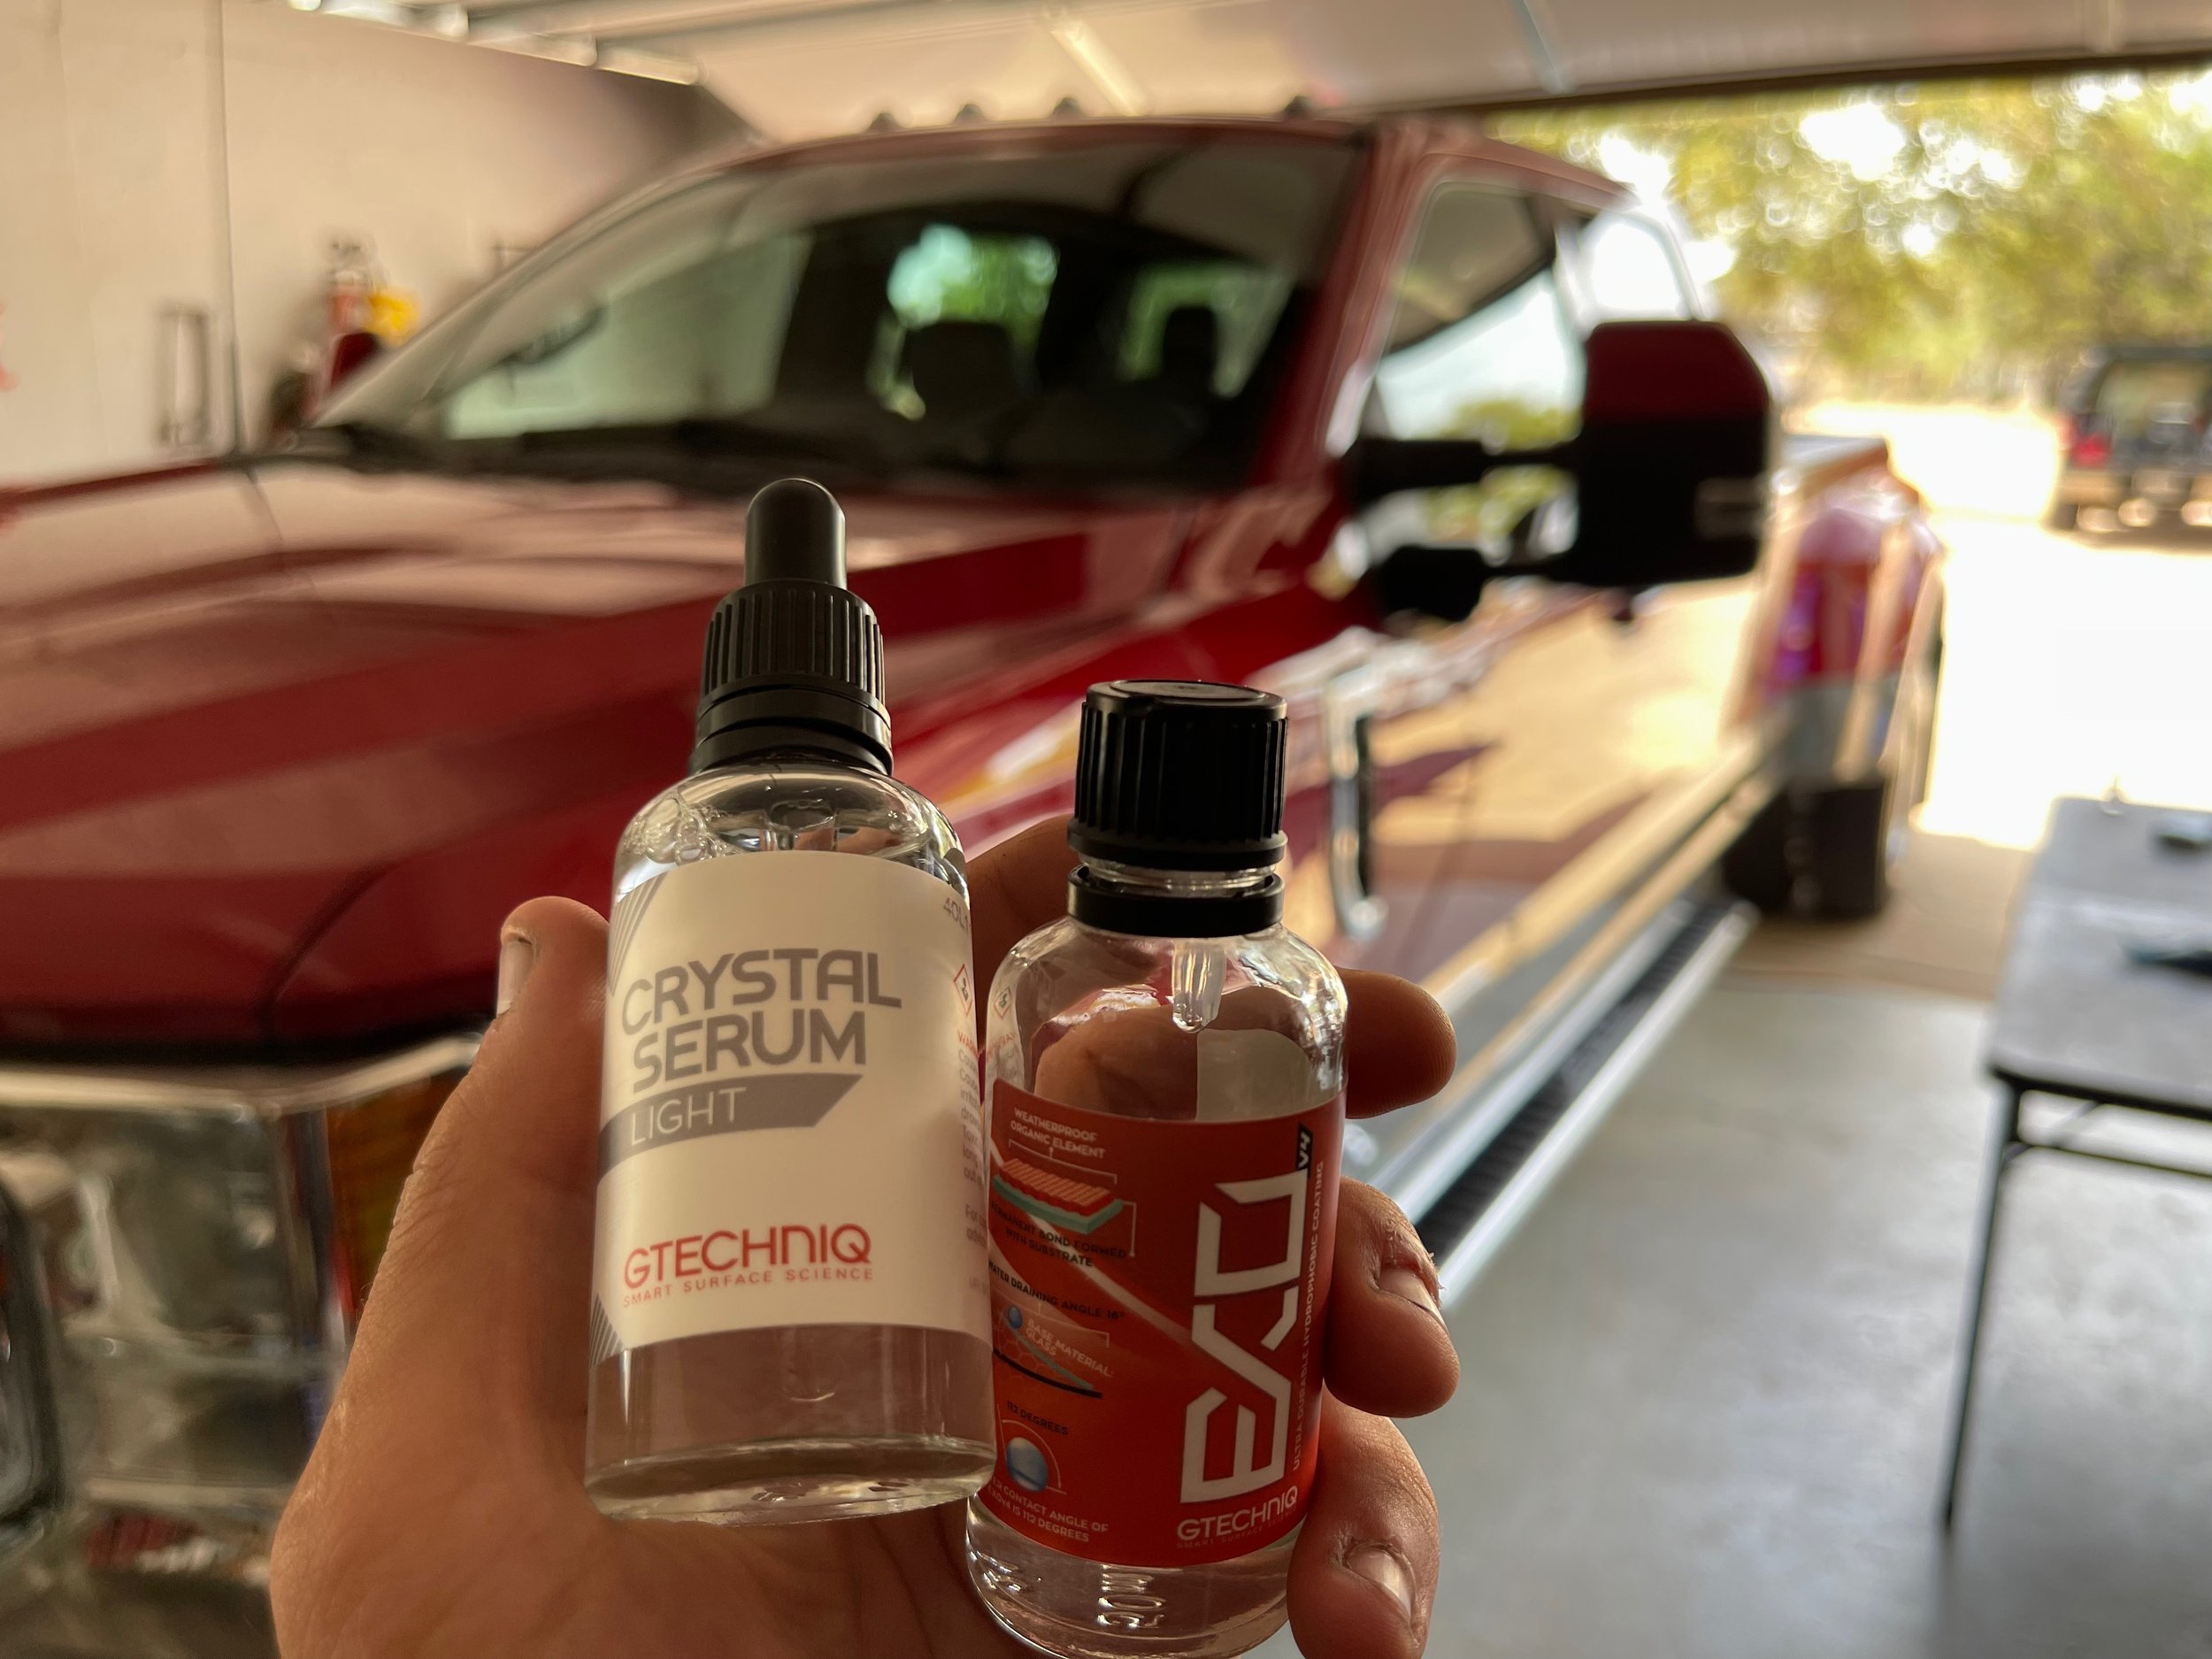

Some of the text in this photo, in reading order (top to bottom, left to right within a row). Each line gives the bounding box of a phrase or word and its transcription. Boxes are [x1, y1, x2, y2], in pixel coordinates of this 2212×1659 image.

[622, 947, 902, 1036] CRYSTAL
[634, 1009, 866, 1094] SERUM
[630, 1087, 747, 1145] LIGHT
[1014, 1107, 1098, 1142] WEATHERPROOF
[1010, 1120, 1051, 1146] ORGANIC
[1052, 1137, 1106, 1159] ELEMENT
[625, 1223, 872, 1289] GTECHNIQ
[1005, 1228, 1027, 1244] WITH
[1029, 1239, 1094, 1267] SUBSTRATE
[1039, 1228, 1070, 1247] BOND
[1074, 1239, 1127, 1259] FORMED
[623, 1267, 873, 1308] SMART SURFACE SCIENCE
[1010, 1278, 1058, 1305] DRAINING
[1062, 1301, 1102, 1317] ANGLE
[1028, 1318, 1054, 1343] BASE
[1179, 1169, 1309, 1503] EXO
[1293, 1161, 1325, 1471] ULTRA DURABLE HYDROPHOBIC COATING
[1025, 1327, 1057, 1356] GLASS
[1020, 1409, 1069, 1435] DEGREES
[1003, 1486, 1048, 1516] CONTACT
[1049, 1510, 1088, 1529] ANGLE
[1092, 1522, 1110, 1532] OF
[1012, 1505, 1022, 1517] IS
[1038, 1517, 1090, 1542] DEGREES
[1177, 1486, 1298, 1540] GTECHNIQ
